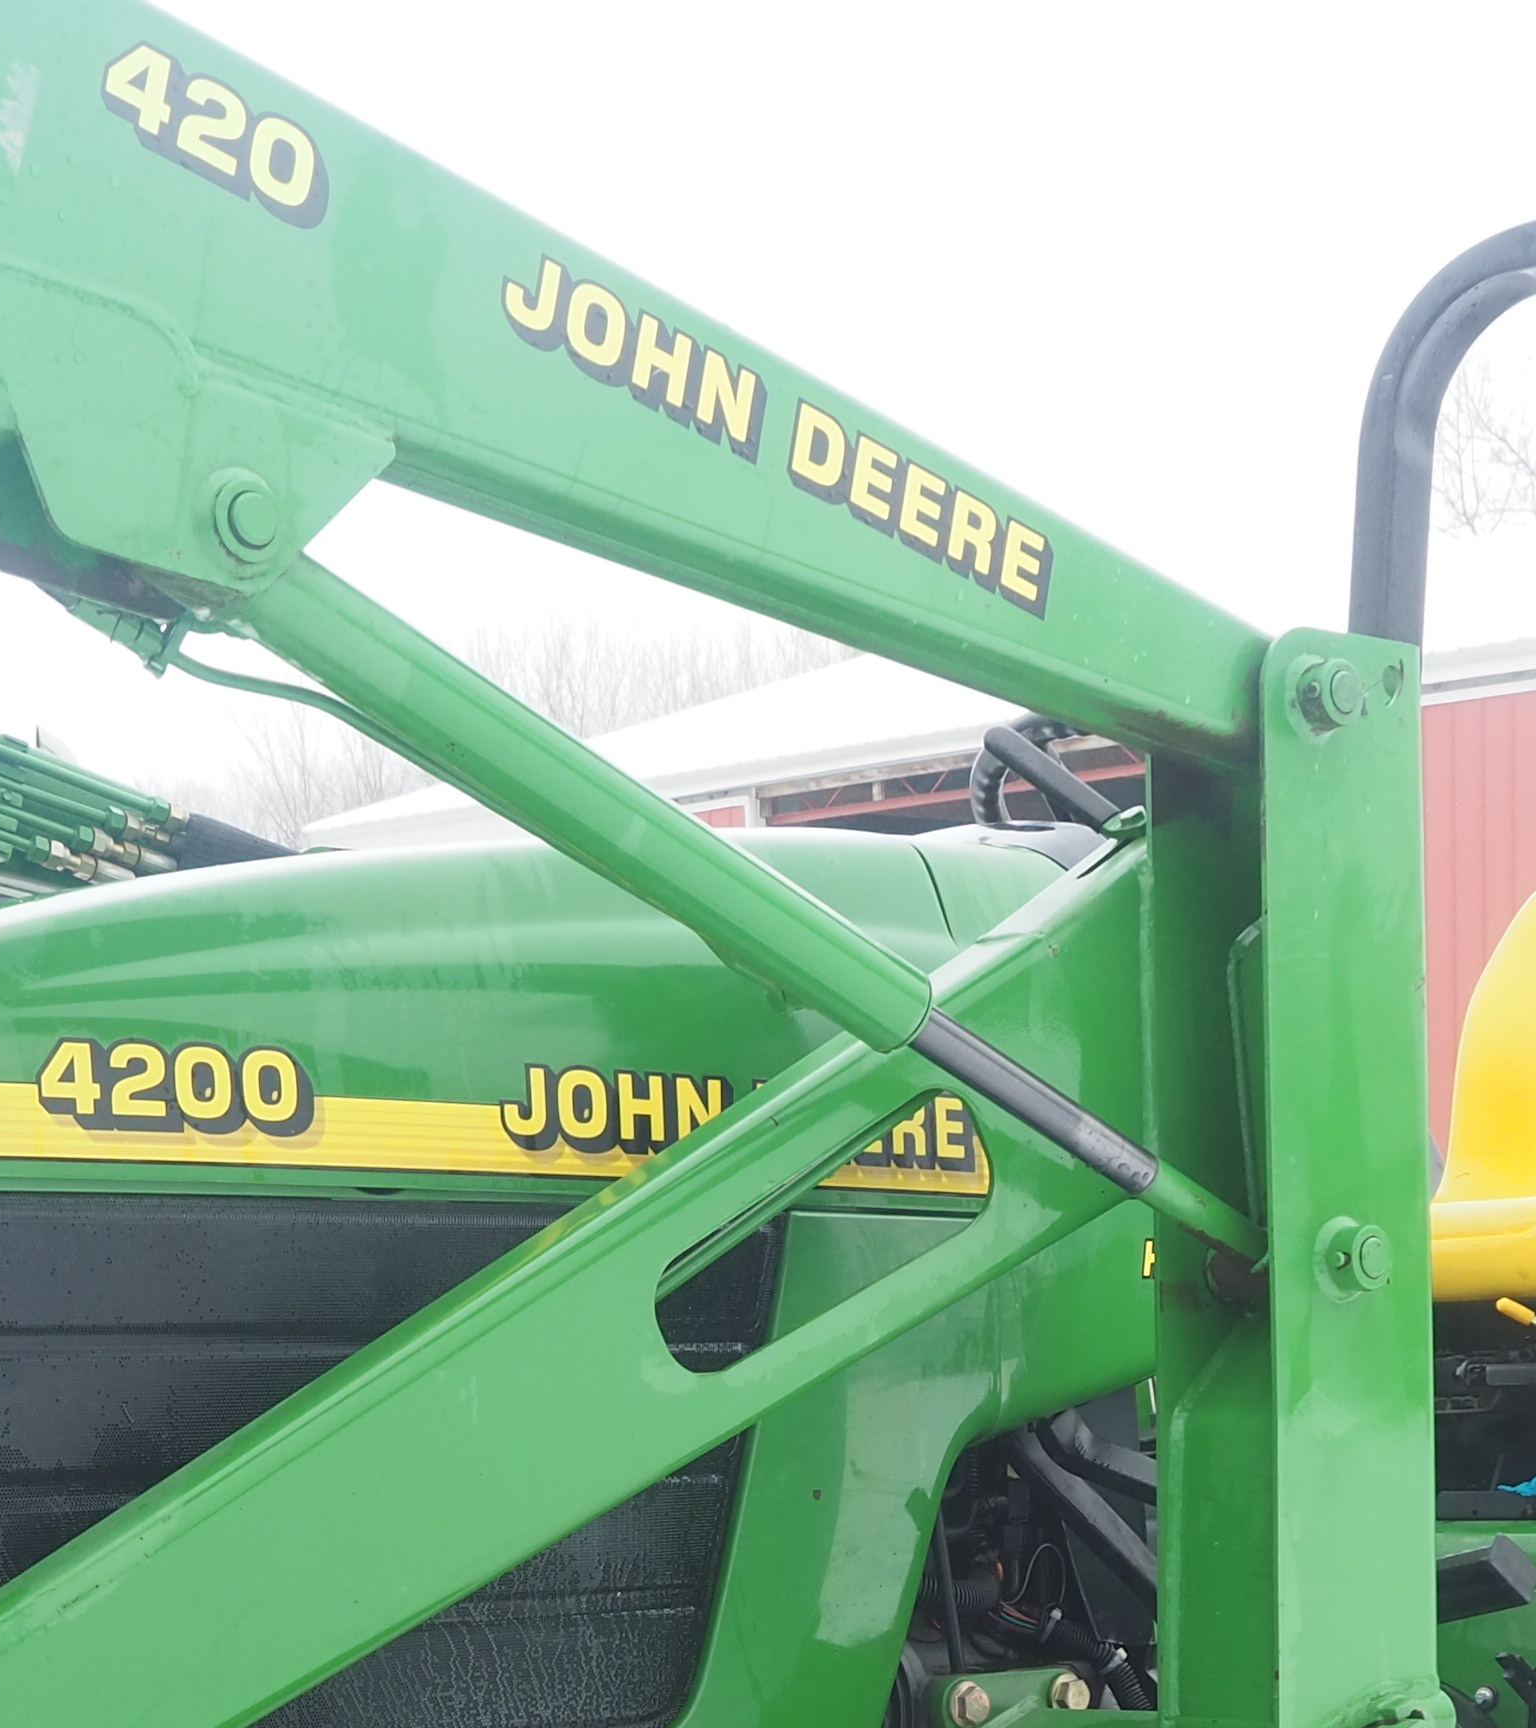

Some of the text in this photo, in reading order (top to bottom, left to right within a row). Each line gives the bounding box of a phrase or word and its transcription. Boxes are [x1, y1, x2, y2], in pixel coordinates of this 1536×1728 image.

[103, 41, 318, 212] 420
[503, 257, 1050, 606] JOHN DEERE
[38, 1040, 306, 1128] 4200
[500, 1065, 730, 1144] JOHN
